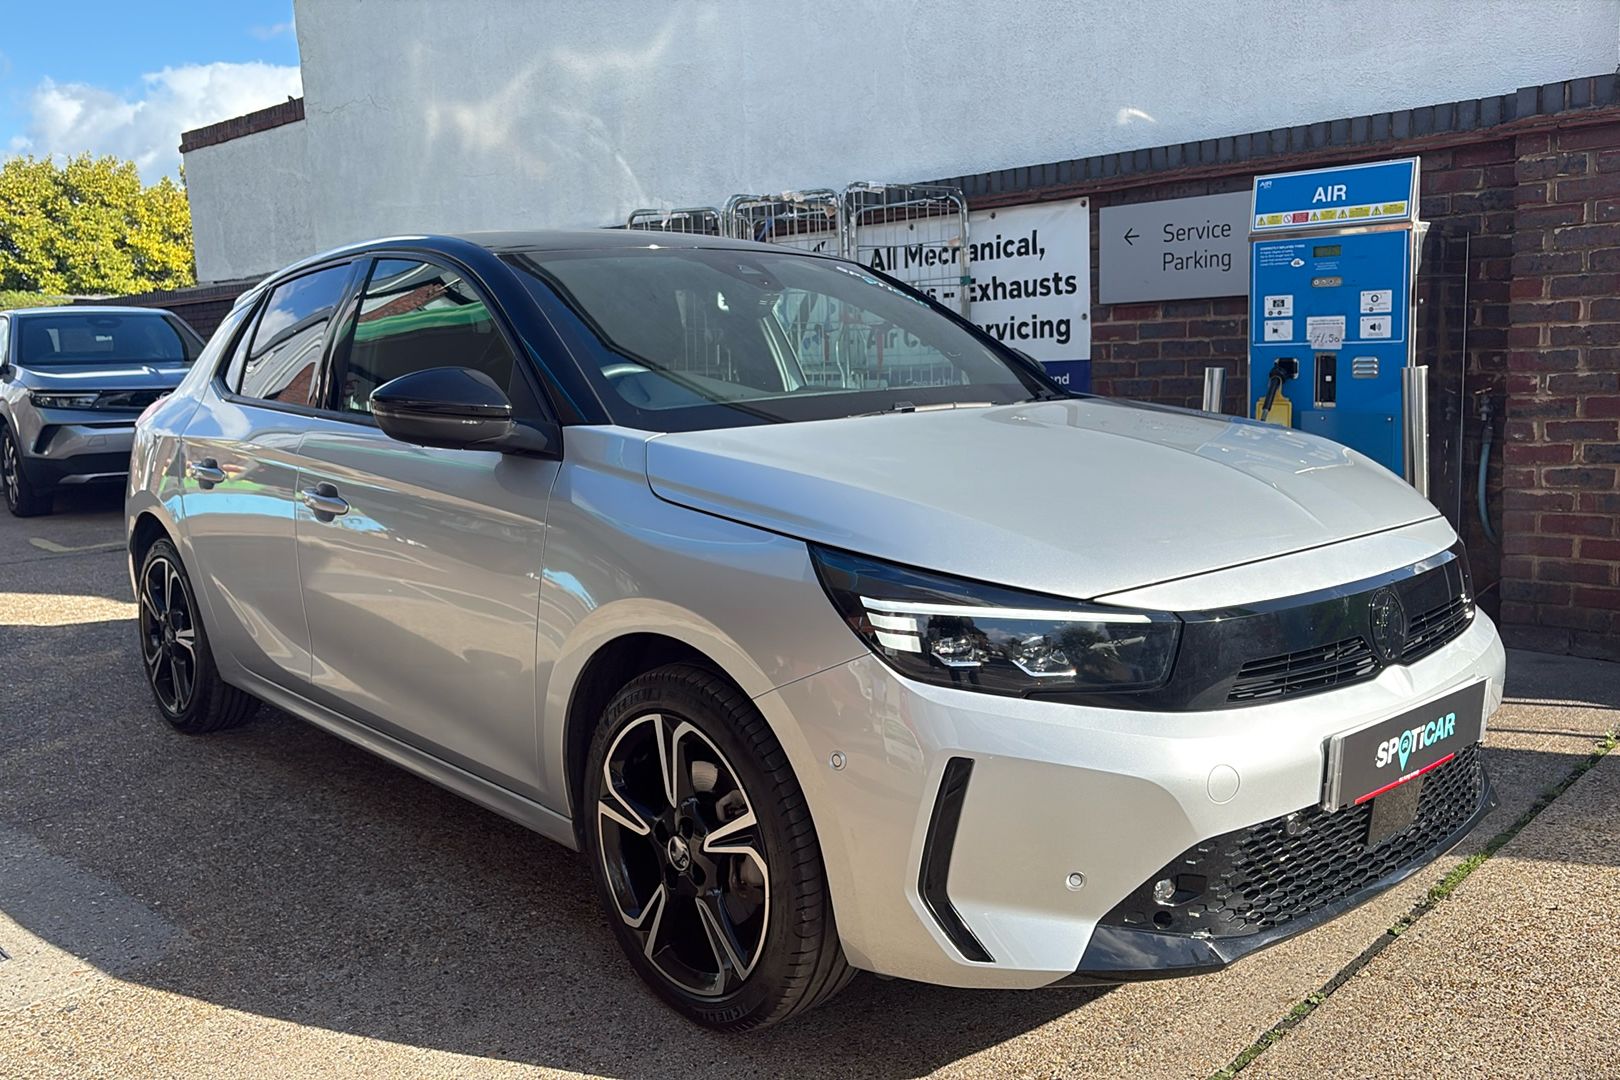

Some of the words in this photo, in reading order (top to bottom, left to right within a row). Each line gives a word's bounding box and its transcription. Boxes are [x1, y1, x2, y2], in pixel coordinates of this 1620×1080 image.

[1312, 184, 1347, 204] AIR
[1163, 220, 1232, 244] Service
[870, 246, 897, 271] All
[1163, 249, 1232, 273] Parking
[969, 271, 1077, 303] Exhausts
[975, 314, 1071, 345] rvicing
[1050, 372, 1070, 385] nd
